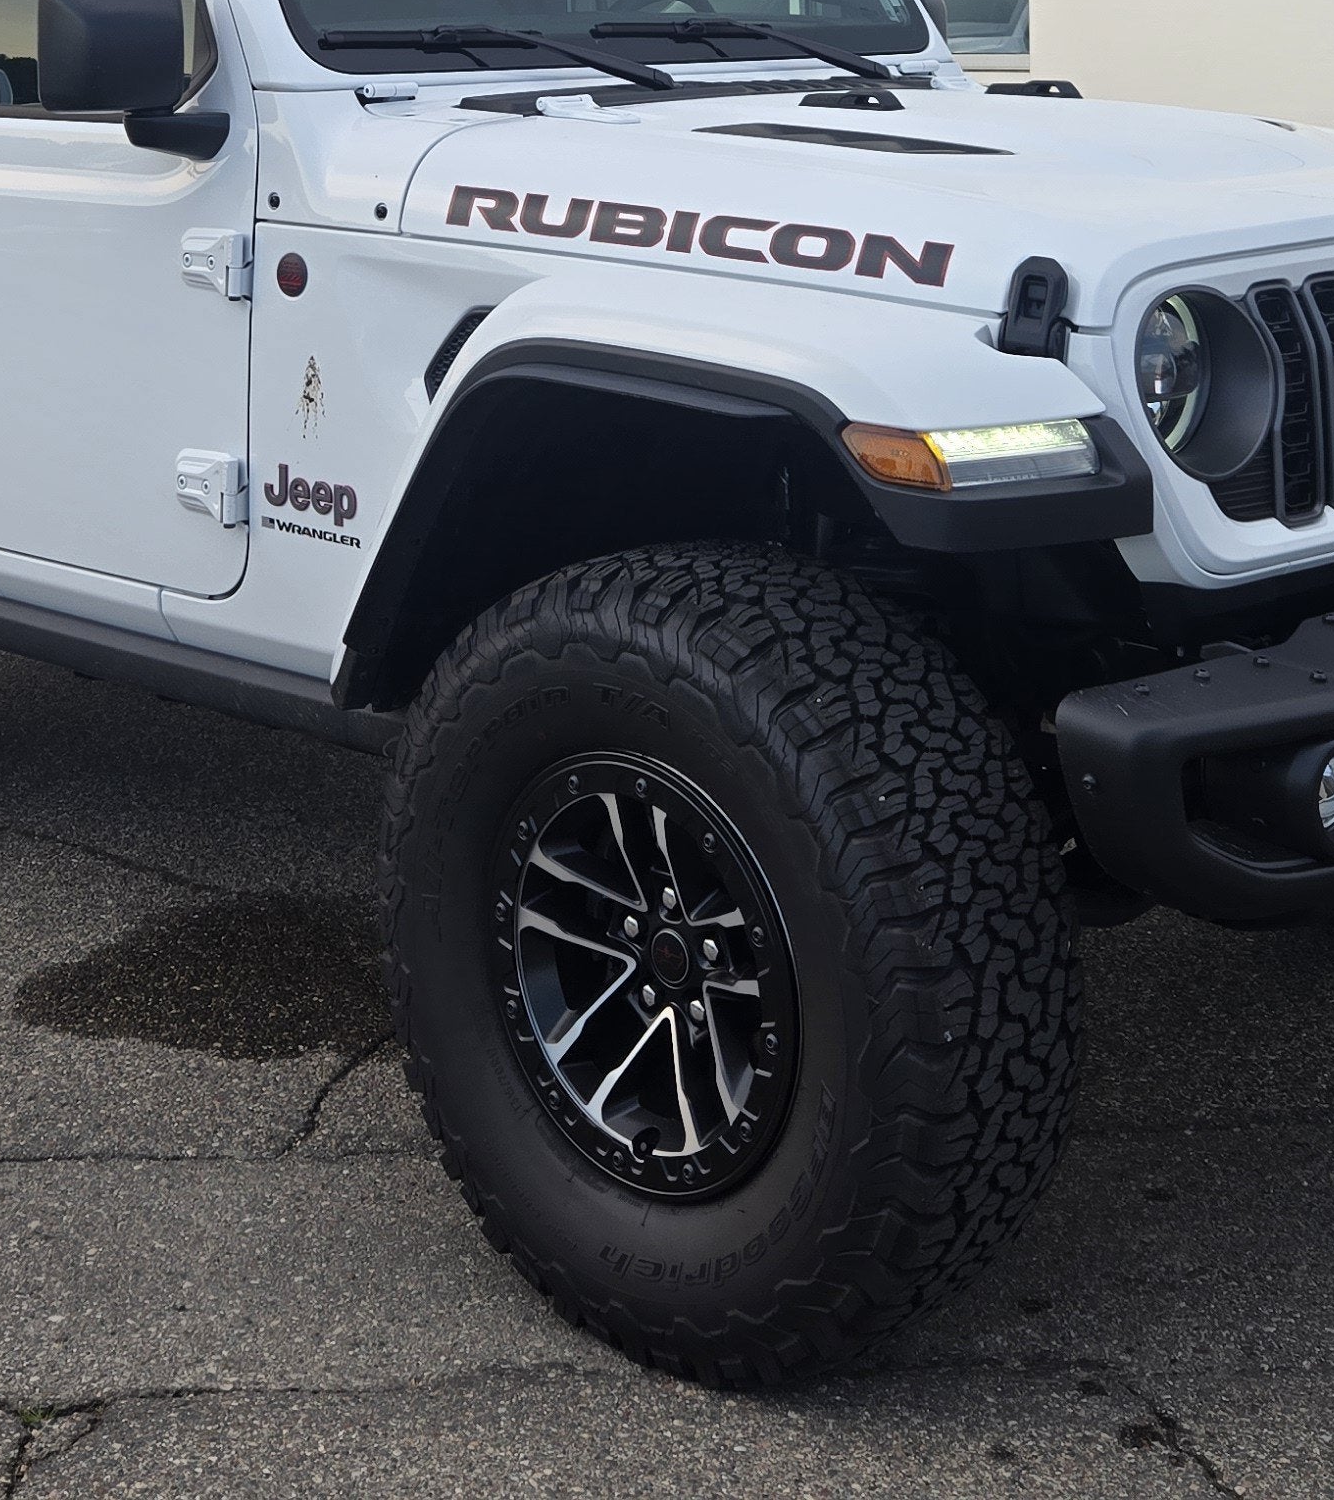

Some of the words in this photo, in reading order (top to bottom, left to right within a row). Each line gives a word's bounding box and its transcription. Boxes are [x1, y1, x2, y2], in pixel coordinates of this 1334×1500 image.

[444, 184, 956, 288] RUBICON
[263, 462, 358, 528] Jeep
[275, 518, 362, 549] WRANGLER
